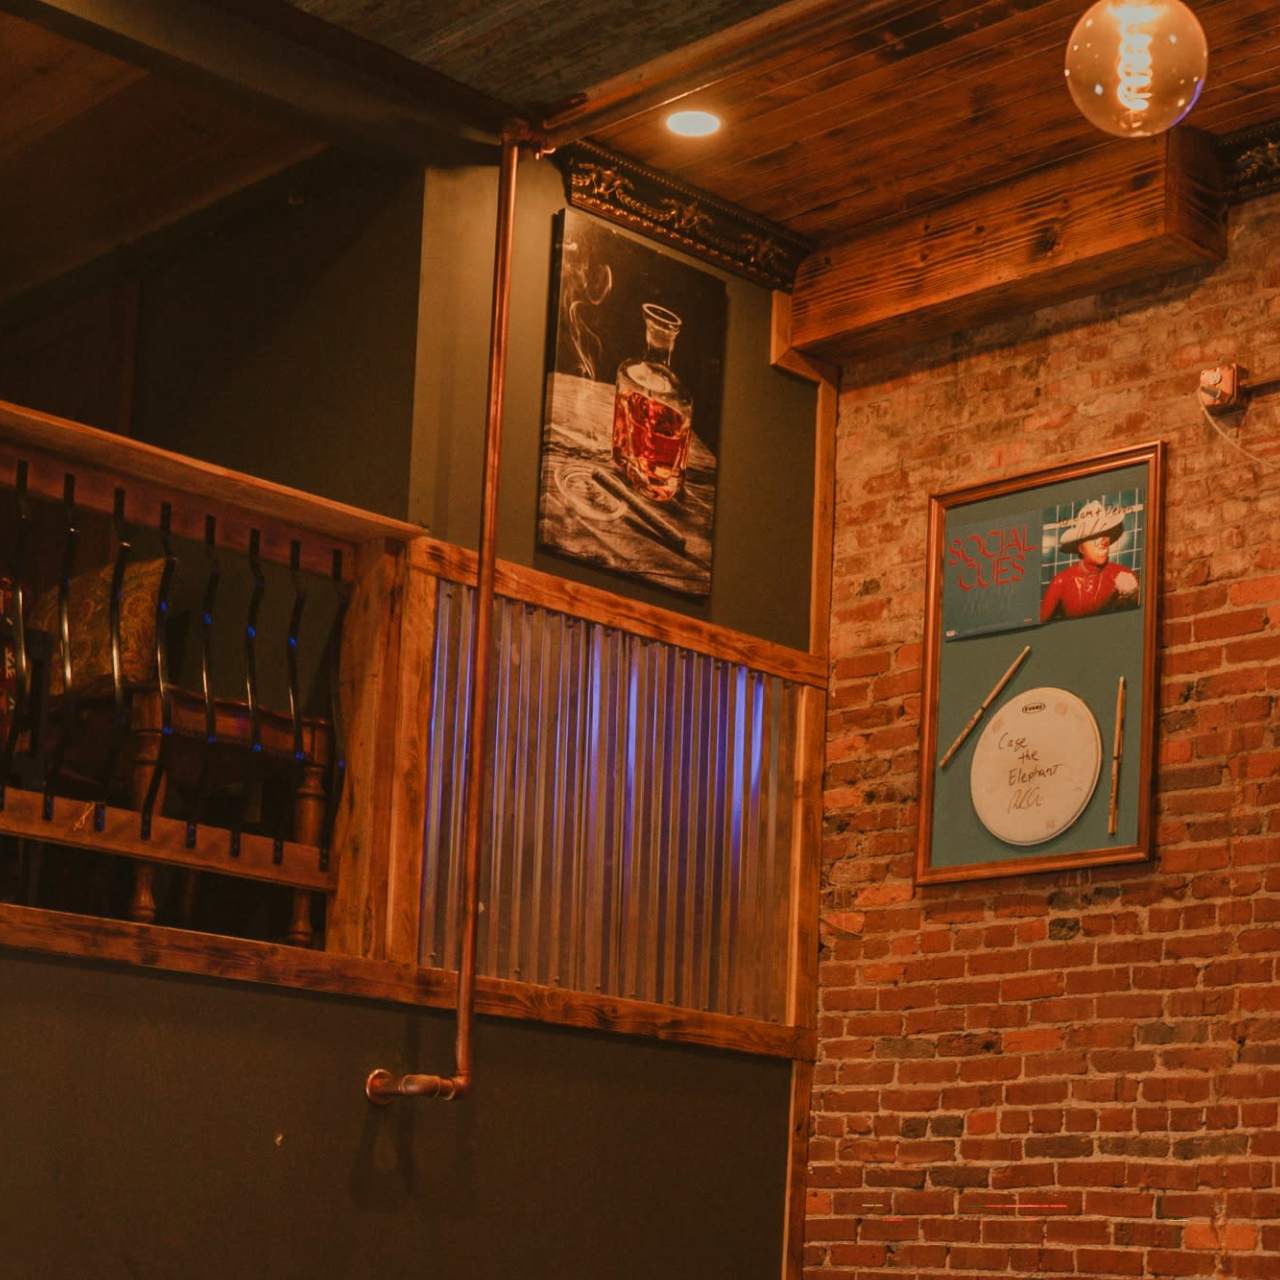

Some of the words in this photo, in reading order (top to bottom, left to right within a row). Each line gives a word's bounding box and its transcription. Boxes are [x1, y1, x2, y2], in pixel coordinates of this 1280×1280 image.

[948, 524, 1040, 568] SOCIAL
[958, 555, 1026, 592] CUES
[998, 732, 1028, 752] Cage
[1018, 750, 1040, 764] the
